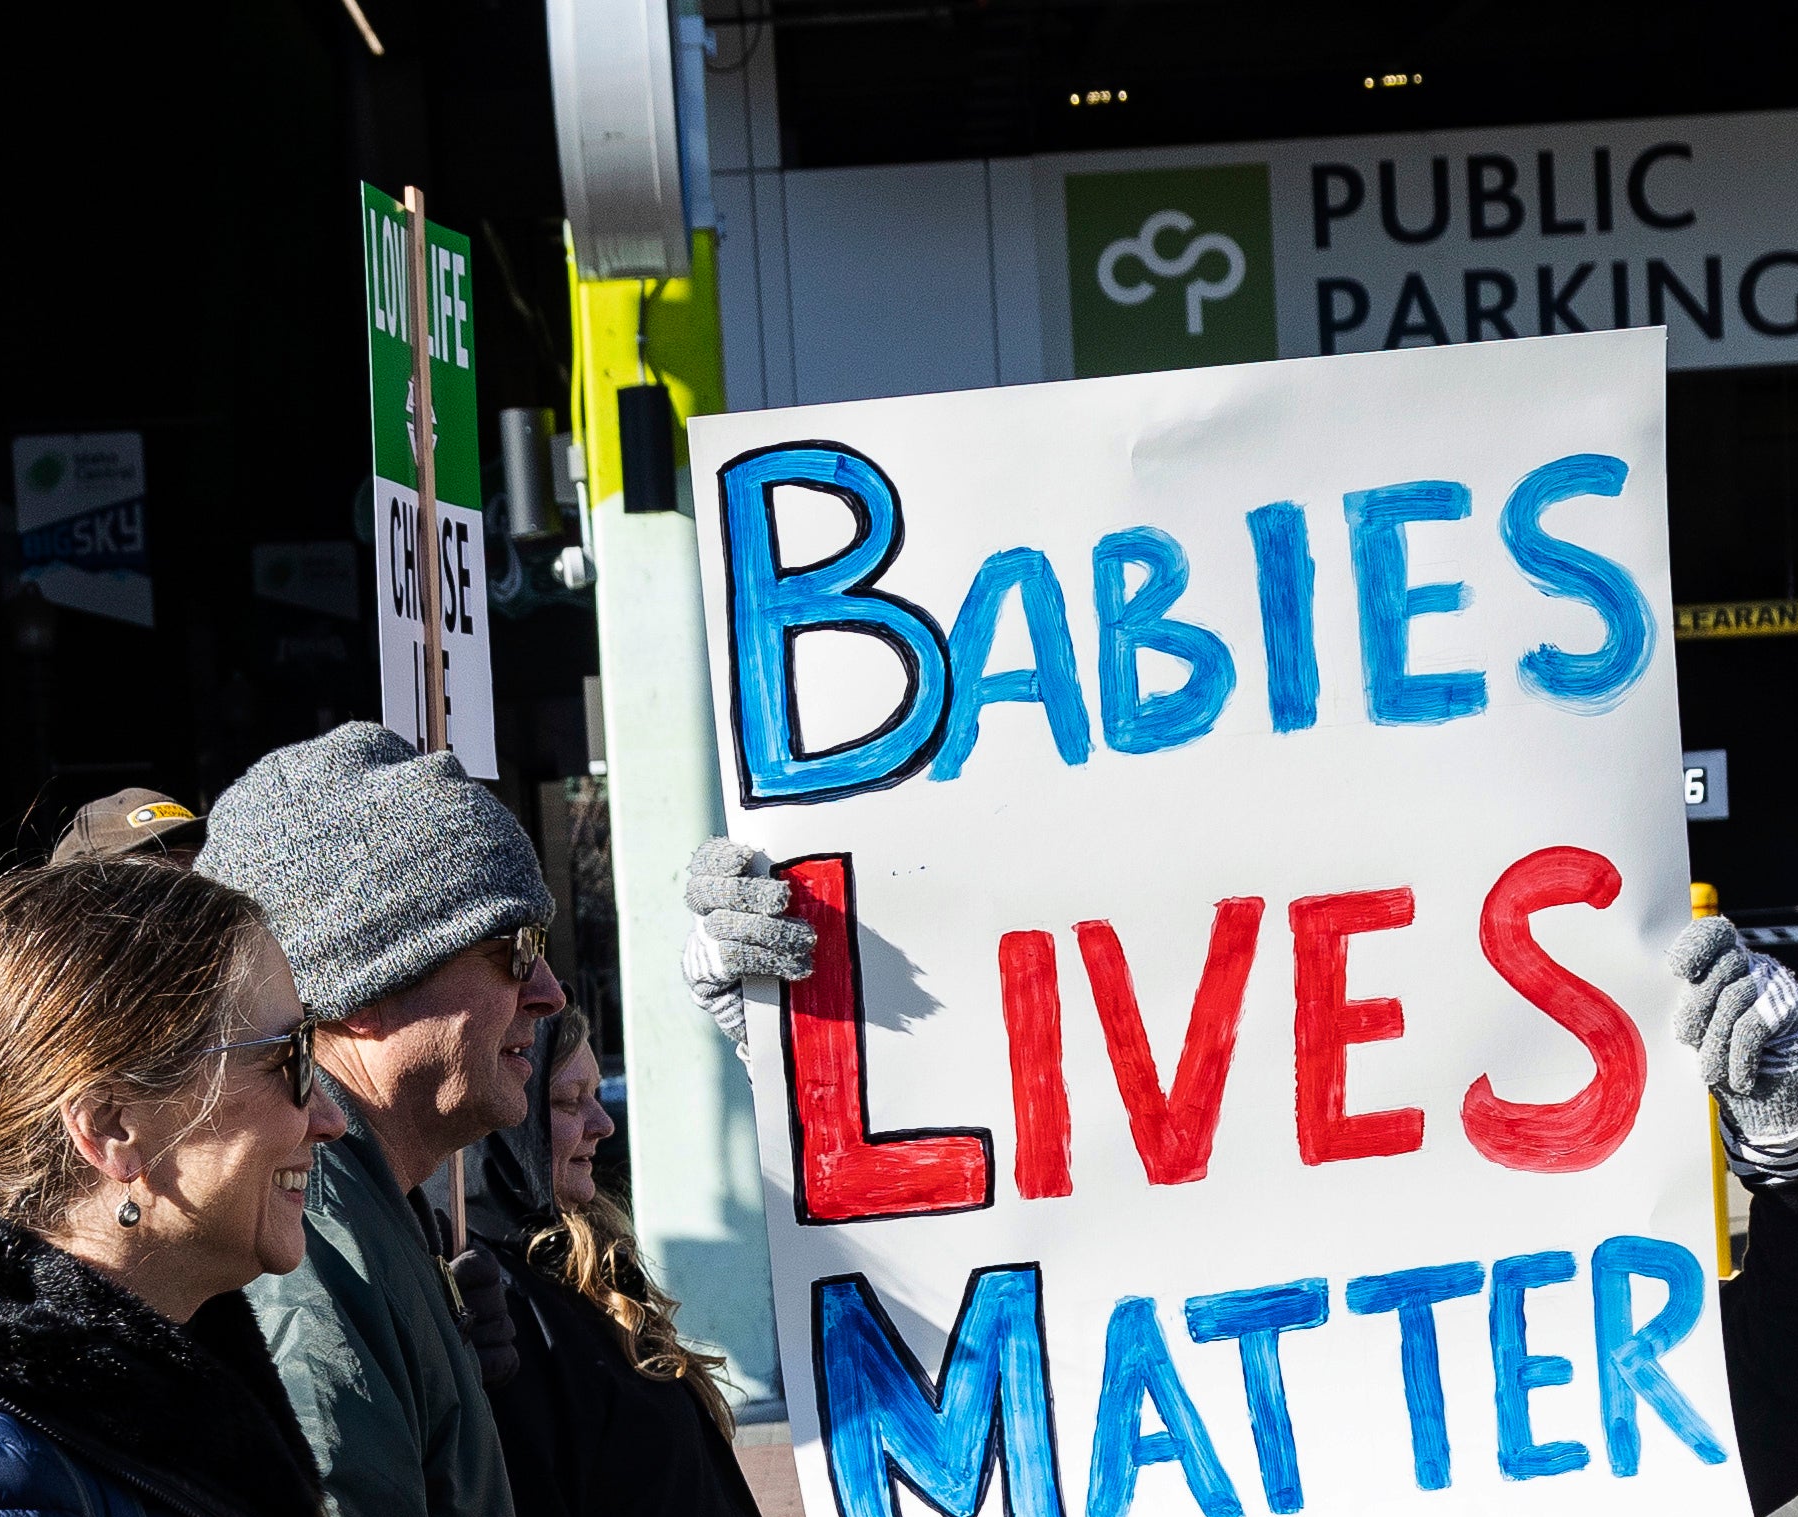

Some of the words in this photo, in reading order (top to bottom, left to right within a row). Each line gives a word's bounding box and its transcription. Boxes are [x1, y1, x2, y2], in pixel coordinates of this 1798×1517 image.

[369, 207, 414, 347] LOV
[427, 243, 470, 370] IFE
[1309, 140, 1699, 251] PUBLIC
[715, 438, 1658, 811] BABIES
[769, 845, 1648, 1227] LIVES
